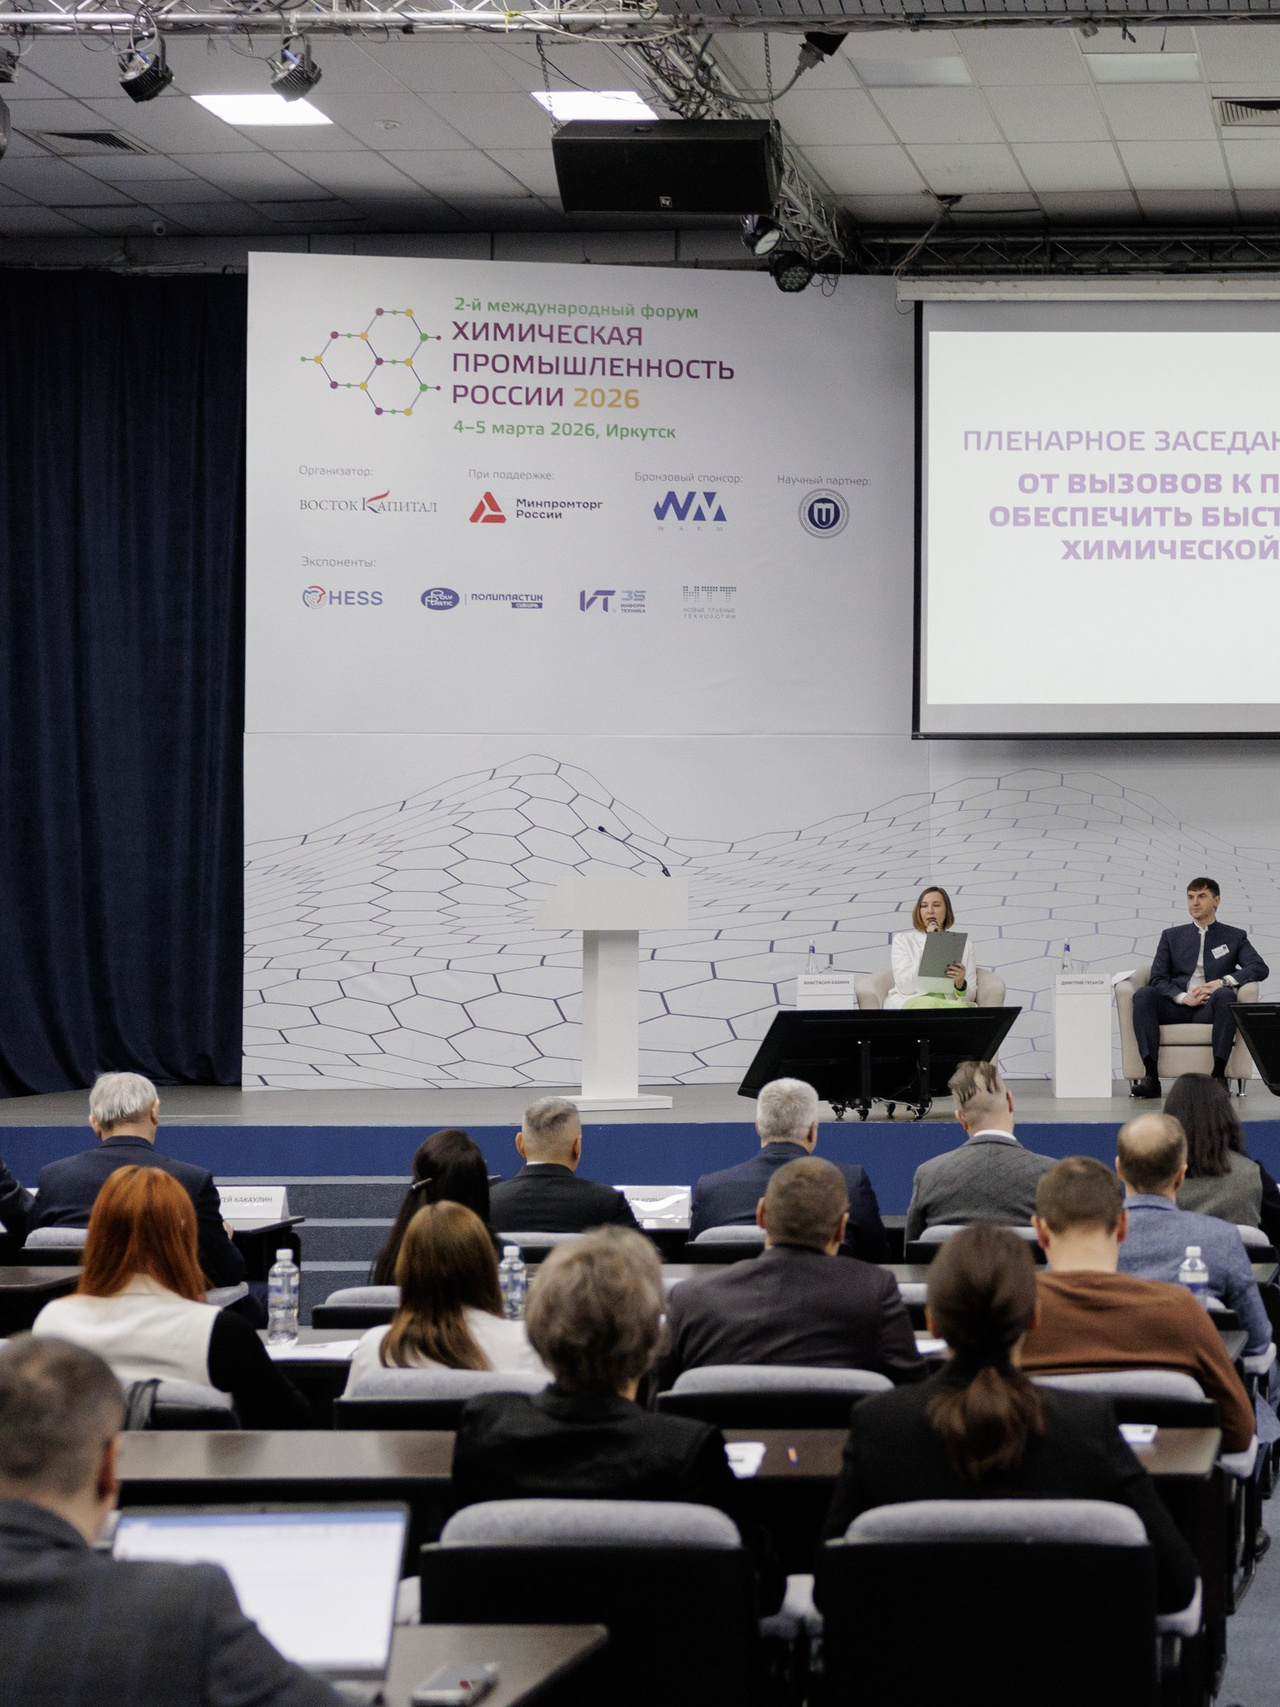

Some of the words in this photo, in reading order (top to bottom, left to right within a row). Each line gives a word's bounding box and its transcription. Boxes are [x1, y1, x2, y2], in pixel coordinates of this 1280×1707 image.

[454, 297, 481, 312] 2-й
[487, 299, 635, 319] международный
[640, 303, 698, 321] форум
[452, 321, 642, 346] ХИМИЧЕСКАЯ
[453, 353, 734, 379] ПРОМЫШЛЕННОСТЬ
[453, 385, 563, 407] РОССИИ
[574, 388, 640, 409] 2026
[492, 424, 545, 439] марта
[550, 422, 600, 439] 2026,
[606, 423, 676, 441] Иркутск
[964, 430, 1145, 451] ПЛЕНАРНОЕ
[299, 465, 373, 476] Организатор:
[468, 469, 489, 479] При
[493, 470, 555, 480] поддержке:
[634, 471, 695, 482] Бронзовый
[698, 474, 743, 484] спонсор:
[777, 475, 822, 486] Научный
[826, 477, 871, 487] партнер:
[1018, 473, 1059, 494] ОТ
[1068, 473, 1223, 494] ВЫЗОВОВ
[1232, 473, 1252, 494] К
[300, 499, 358, 511] ВОСТОК
[516, 499, 603, 510] Минпромторг
[516, 509, 562, 519] России
[989, 506, 1192, 527] ОБЕСПЕЧИТЬ
[1061, 535, 1280, 560] ХИМИЧЕСКОЙ
[301, 556, 376, 567] Экспоненты:
[329, 590, 383, 605] HESS
